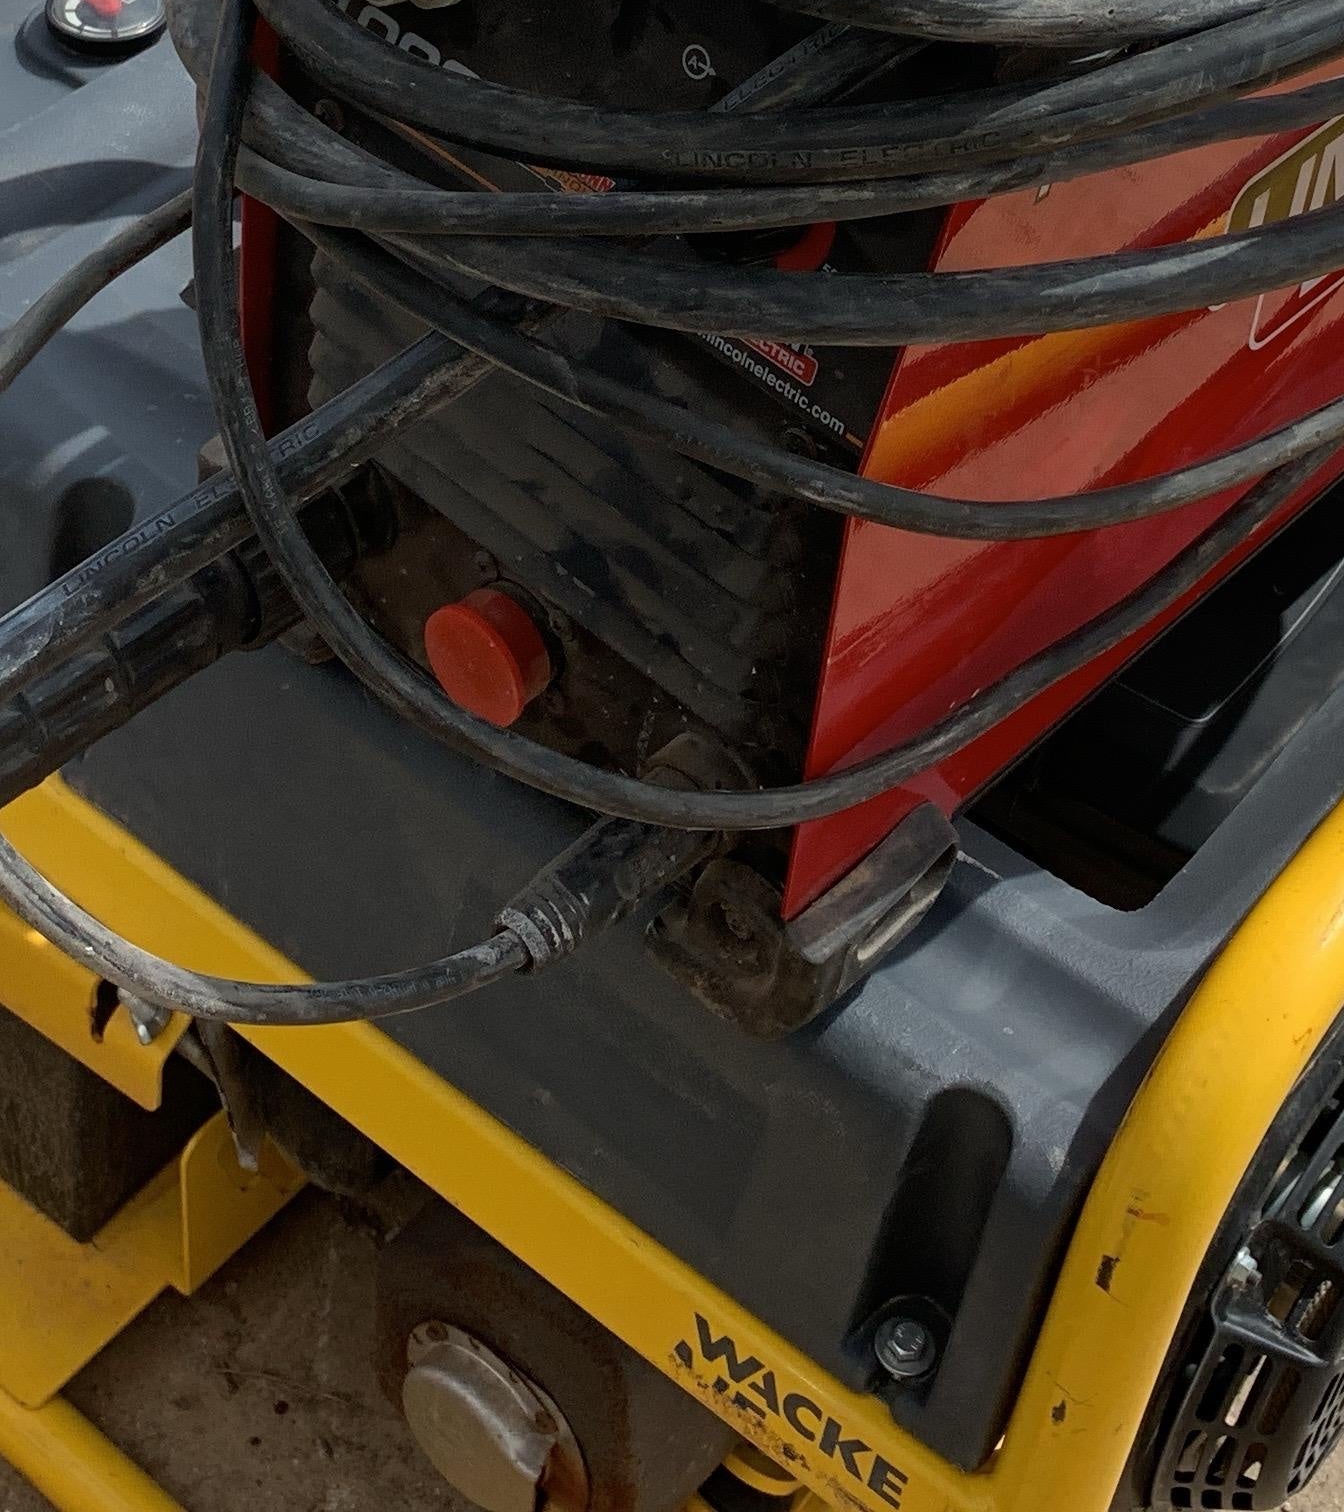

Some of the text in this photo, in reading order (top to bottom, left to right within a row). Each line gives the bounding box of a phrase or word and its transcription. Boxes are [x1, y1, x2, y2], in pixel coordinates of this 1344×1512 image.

[674, 130, 1002, 170] LINCOLN ELECTRIC
[61, 512, 177, 598] LINCOLN
